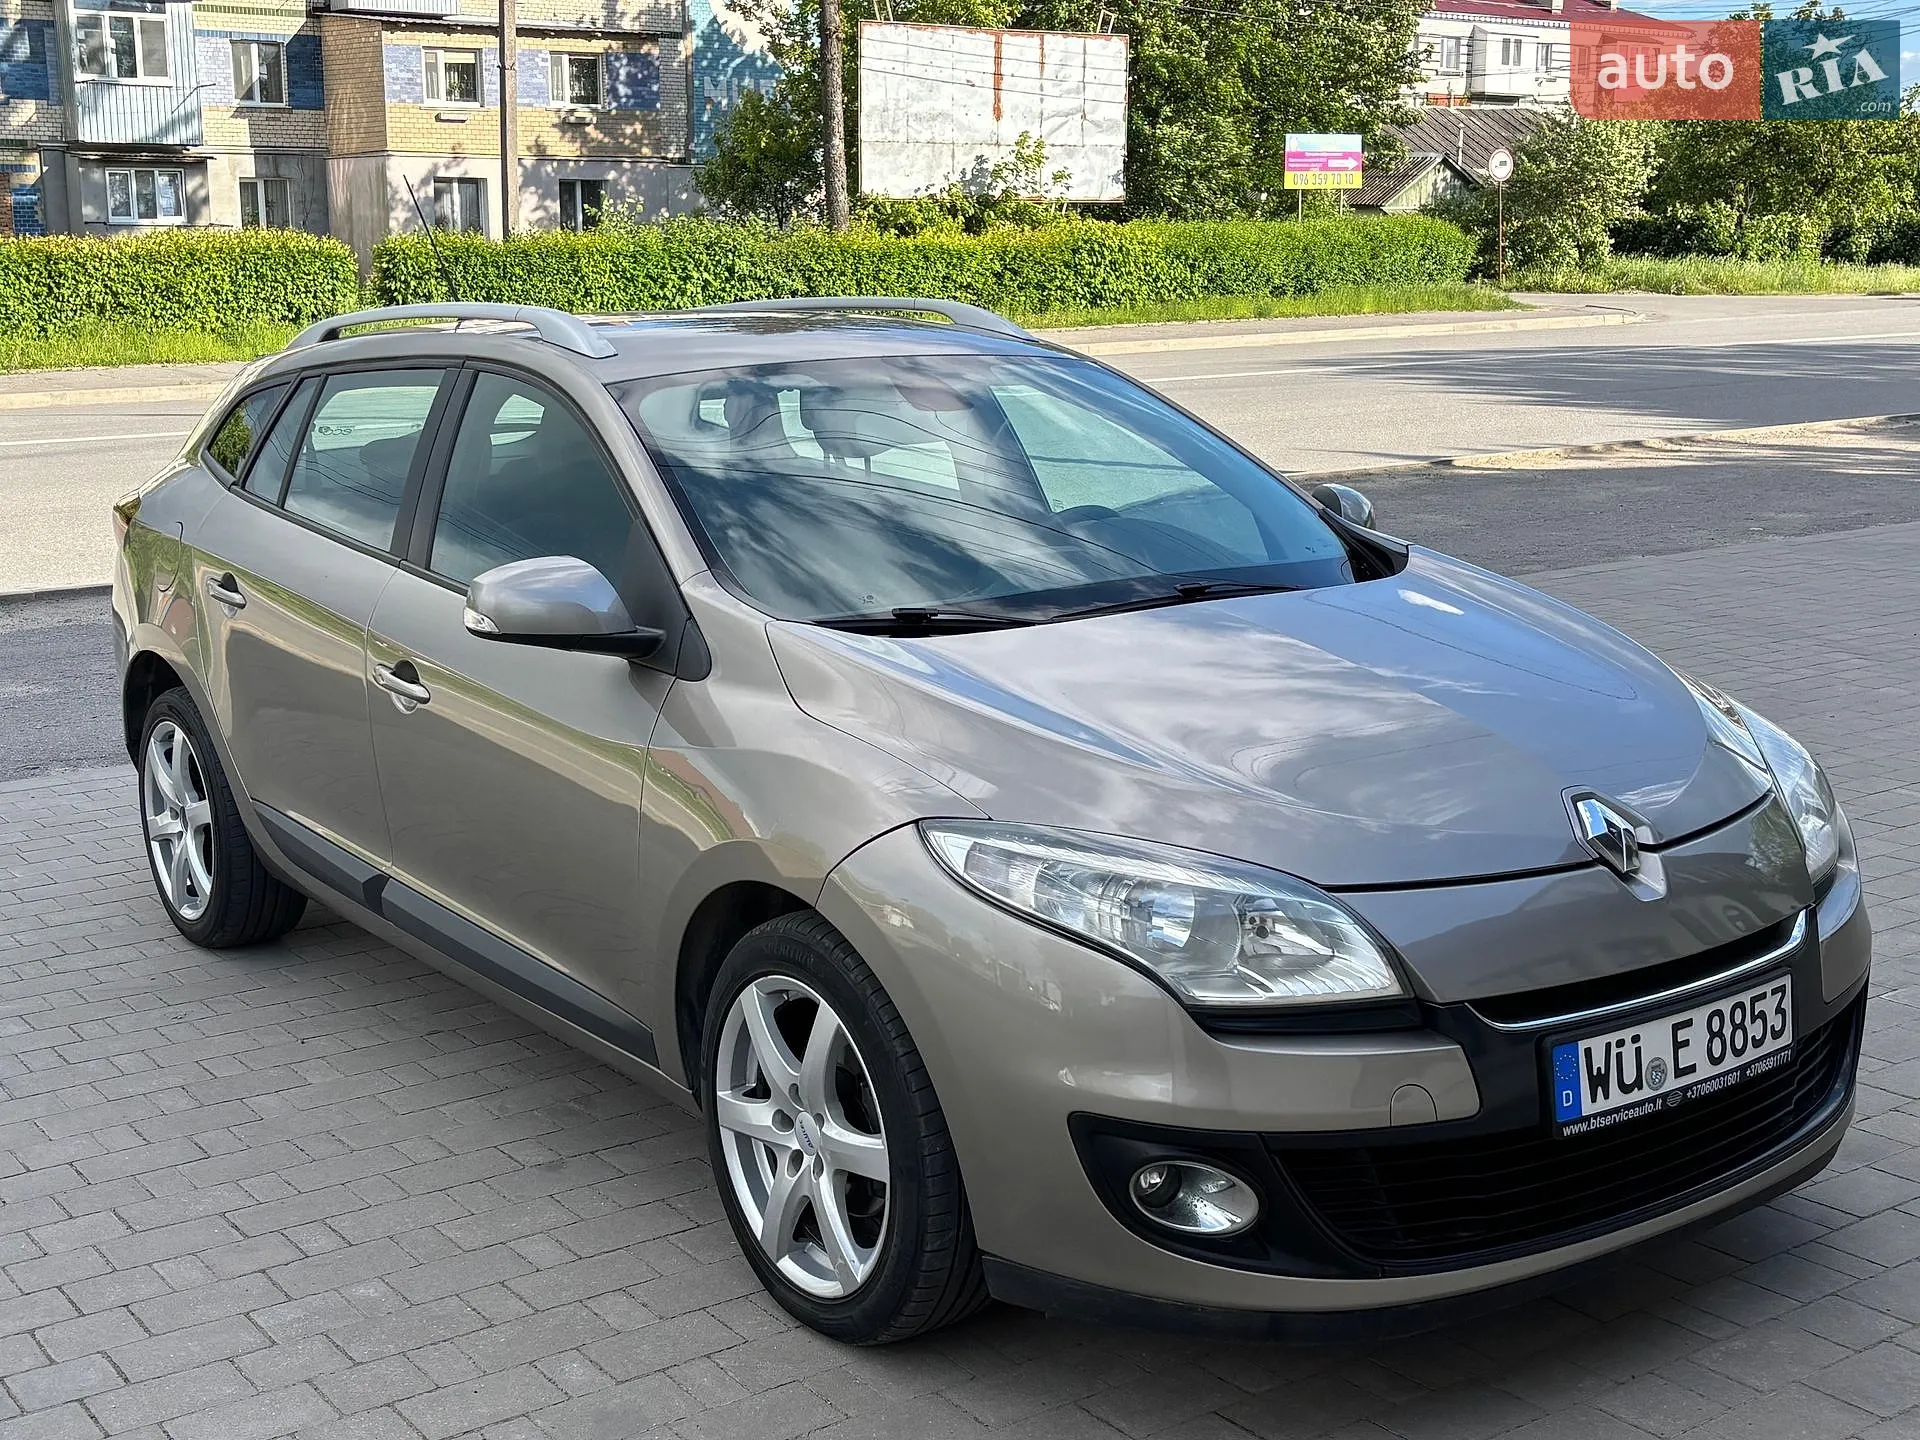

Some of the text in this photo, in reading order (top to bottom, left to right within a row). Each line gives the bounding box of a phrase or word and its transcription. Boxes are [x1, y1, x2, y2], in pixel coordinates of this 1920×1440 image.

[1293, 173, 1354, 186] 096 359 70 10
[1584, 983, 1787, 1104] WÜ E 8853
[1562, 1090, 1573, 1107] D
[1562, 1098, 1663, 1137] www.btserviceauto.lt
[1686, 1070, 1741, 1099] +37060031601
